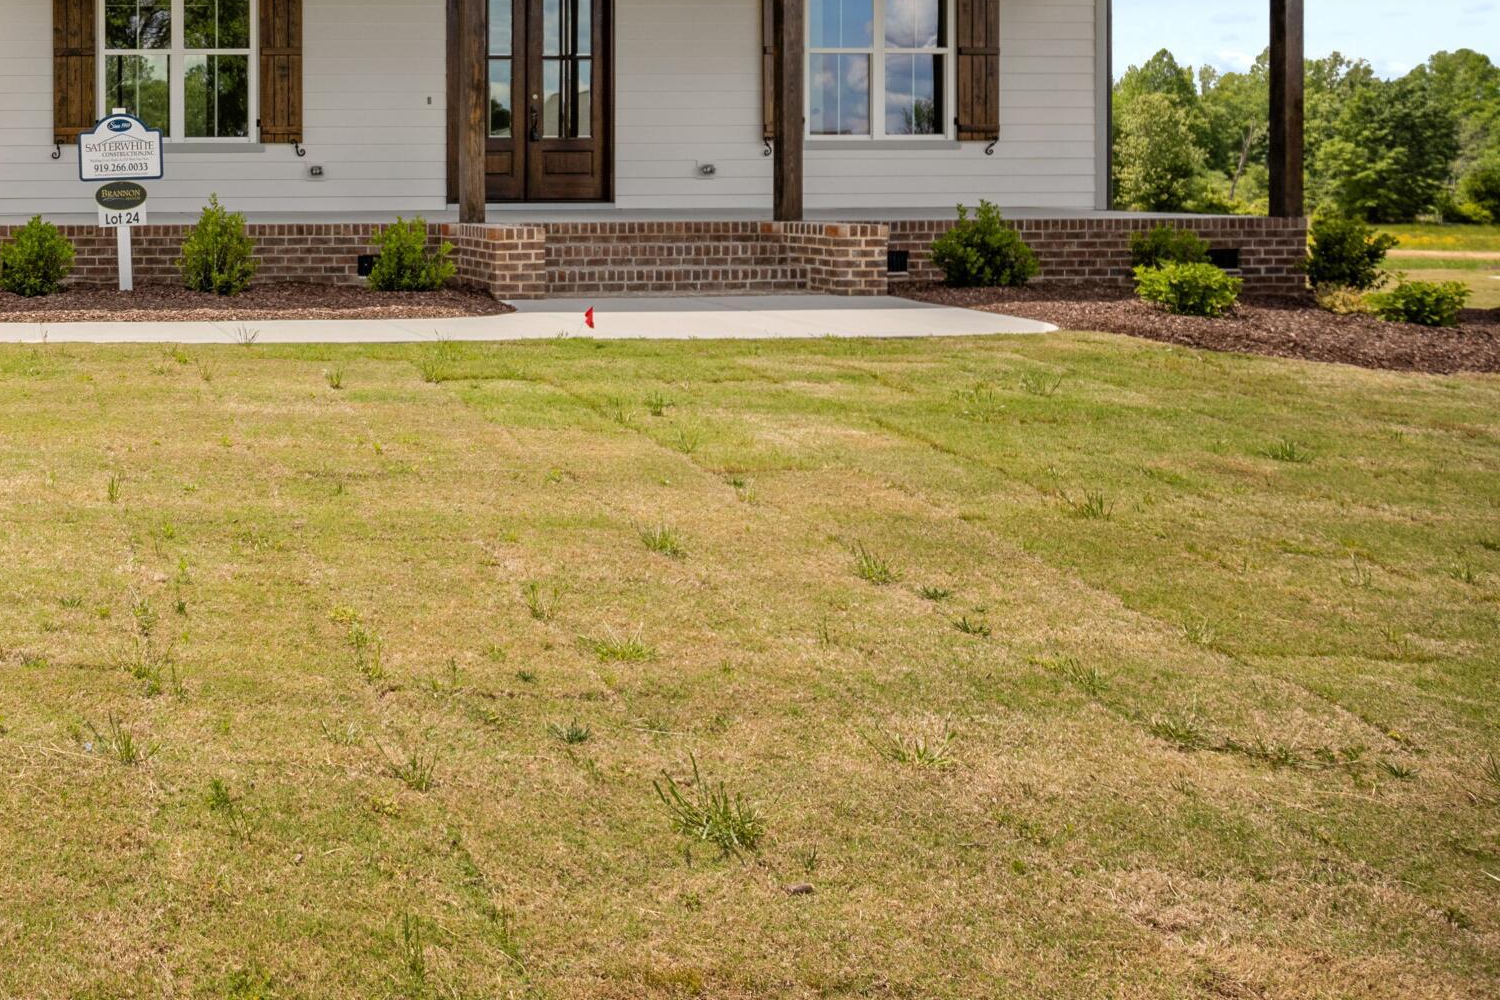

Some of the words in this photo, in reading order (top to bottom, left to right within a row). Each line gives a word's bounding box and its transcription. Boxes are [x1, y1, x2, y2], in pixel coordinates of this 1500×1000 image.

[85, 140, 155, 153] SATTERWHITE
[93, 163, 149, 173] 919.266.0033
[101, 188, 141, 198] BRANNON
[105, 213, 122, 225] Lot
[125, 212, 140, 224] 24
